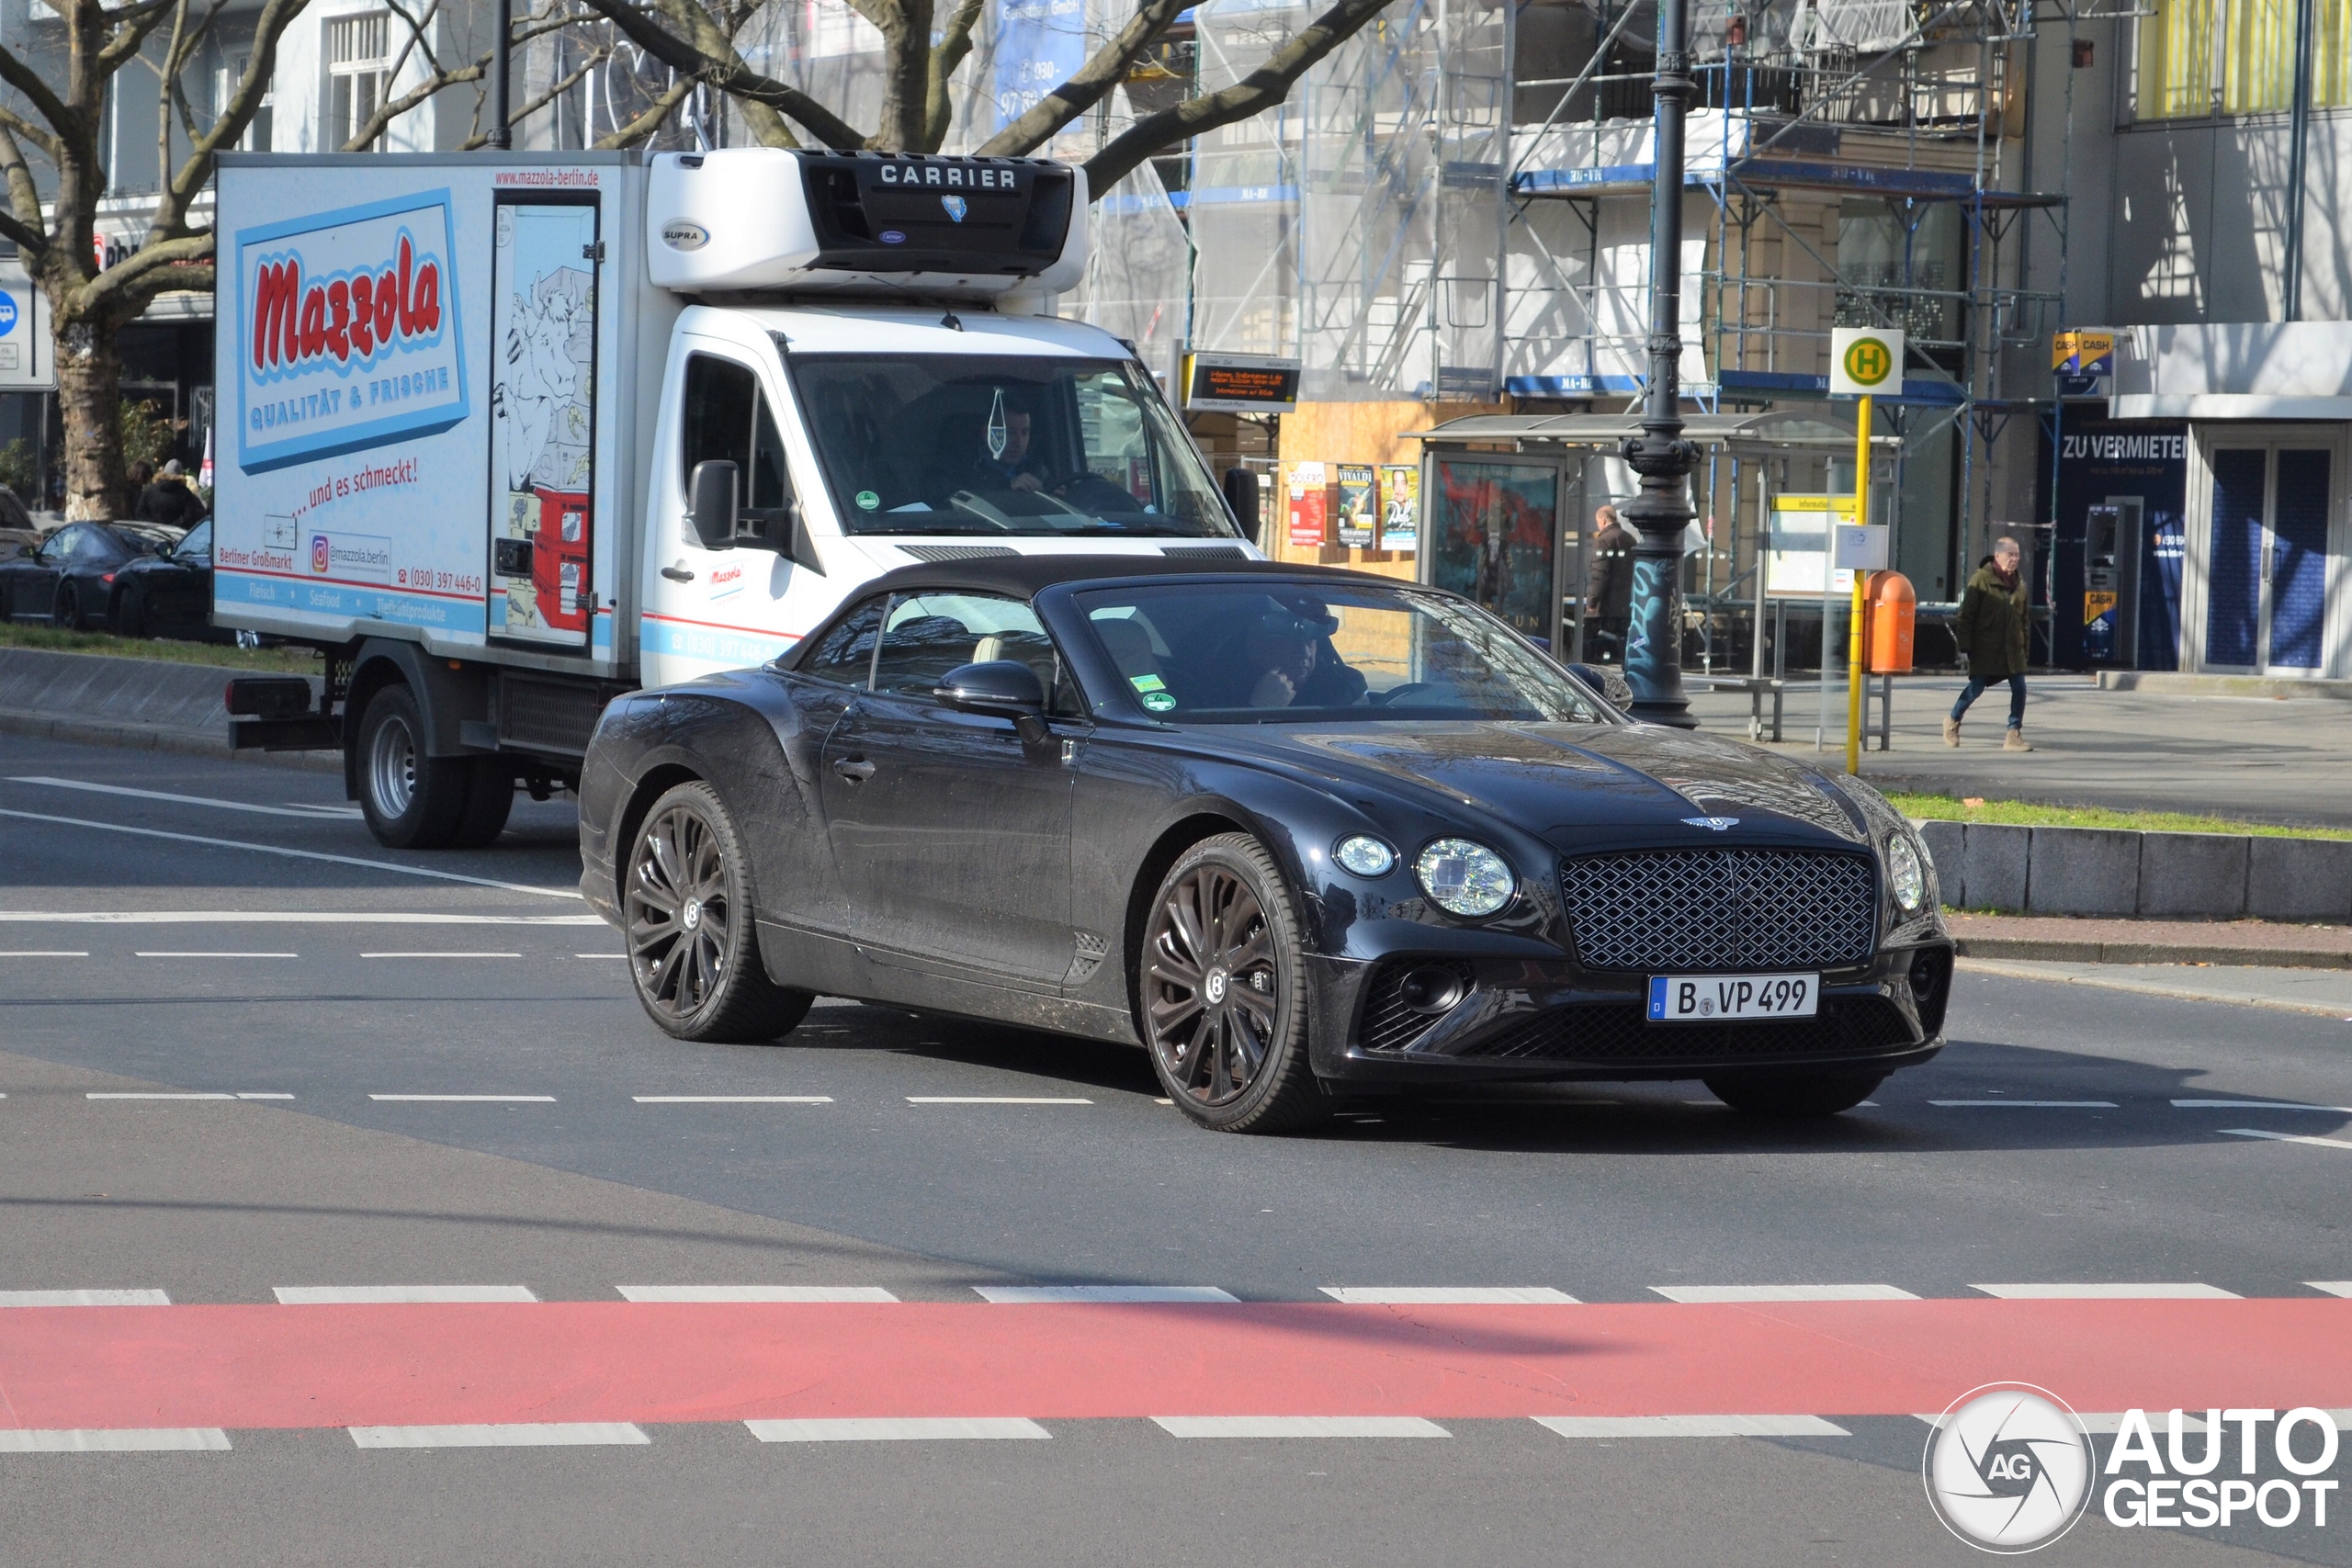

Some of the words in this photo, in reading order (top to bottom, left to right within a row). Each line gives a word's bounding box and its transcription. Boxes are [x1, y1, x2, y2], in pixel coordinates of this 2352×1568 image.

[496, 168, 598, 185] www.mazzola-berlin.de
[881, 165, 1014, 187] CARRIER
[664, 231, 697, 240] SUPRA
[254, 235, 439, 369] Mazzola
[2055, 341, 2077, 350] CASH
[2083, 340, 2109, 350] CASH
[1857, 348, 1880, 374] H
[250, 389, 341, 432] QUALITÄT
[350, 386, 362, 408] &
[370, 366, 449, 403] FRISCHE
[2063, 435, 2087, 458] ZU
[310, 476, 332, 509] und
[336, 481, 349, 498] es
[354, 457, 418, 492] schmeckt!
[1339, 471, 1372, 482] VIVALDI
[220, 547, 249, 565] Berliner
[252, 550, 291, 570] Großmarkt
[330, 546, 388, 565] @mazzola.berlin
[411, 567, 433, 590] (030)
[437, 572, 453, 589] 397
[455, 574, 481, 592] 446-0
[712, 566, 741, 585] Mazzola
[249, 582, 275, 600] Fleisch
[310, 590, 340, 609] Seafood
[377, 597, 446, 623] Tiefkühlprodukte
[2090, 594, 2112, 604] CASH
[687, 634, 714, 658] (030)
[719, 639, 739, 658] 397
[741, 644, 772, 662] 446-0
[1654, 1003, 1660, 1011] D
[1679, 983, 1696, 1013] B
[1719, 981, 1752, 1013] VP
[1758, 979, 1806, 1011] 499
